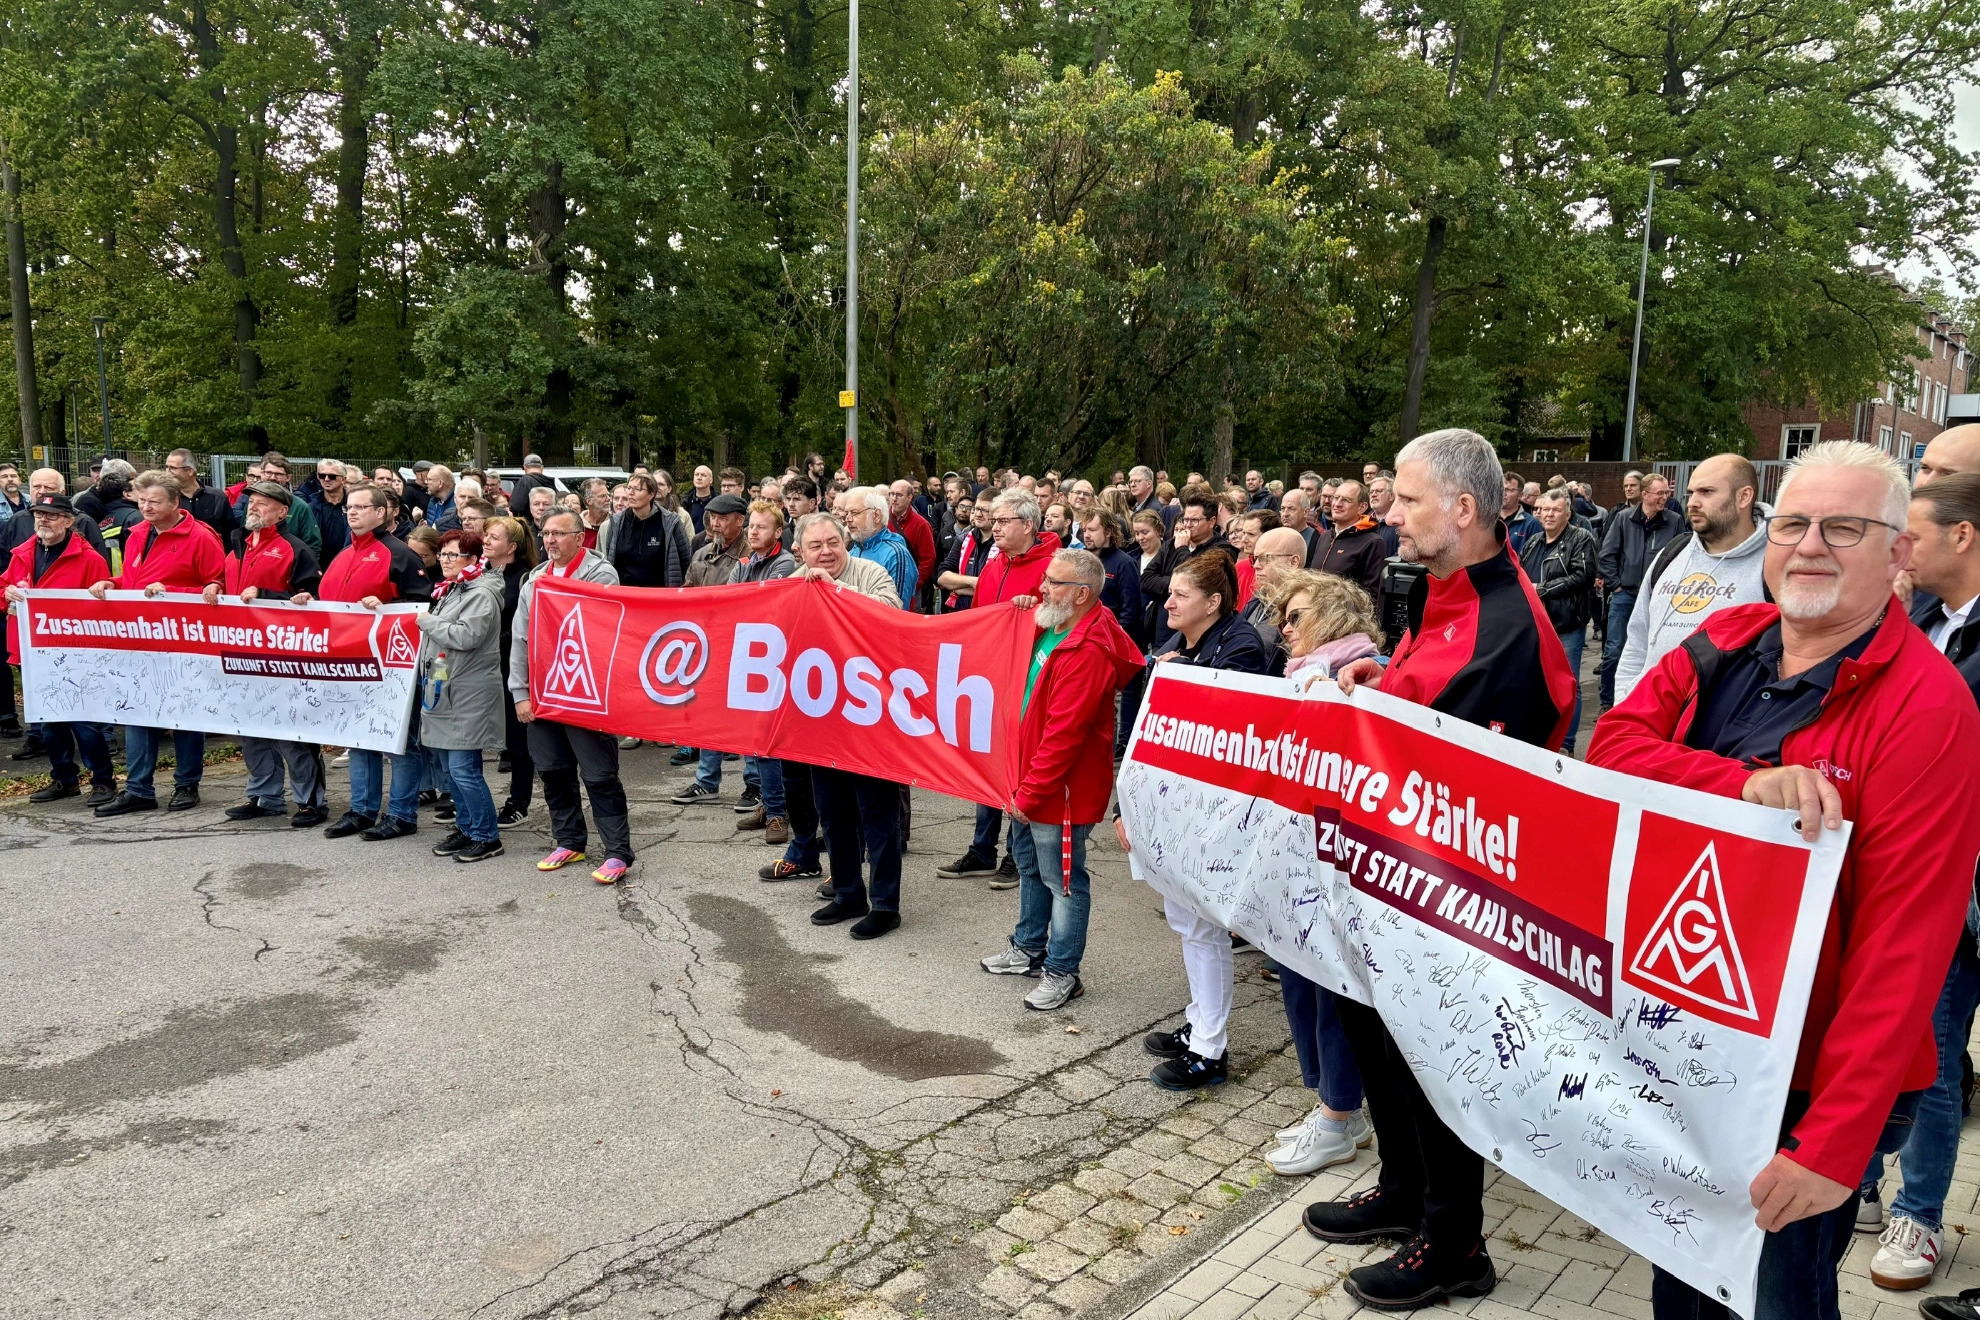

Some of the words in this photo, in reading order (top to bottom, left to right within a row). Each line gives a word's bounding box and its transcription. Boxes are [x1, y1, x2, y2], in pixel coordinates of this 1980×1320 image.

[1658, 579, 1696, 597] Hard
[1693, 580, 1737, 600] Rock
[34, 612, 179, 641] Zusammenhalt
[181, 616, 206, 643] ist
[208, 624, 262, 648] unsere
[266, 623, 329, 653] Stärke!
[224, 656, 267, 674] ZUKUNFT
[270, 660, 301, 675] STATT
[301, 661, 378, 678] KAHLSCHLAG
[727, 621, 996, 754] Bosch
[1387, 769, 1520, 882] Stärke!
[1363, 850, 1444, 908] STATT
[1435, 883, 1603, 998] KAHLSCHLAG
